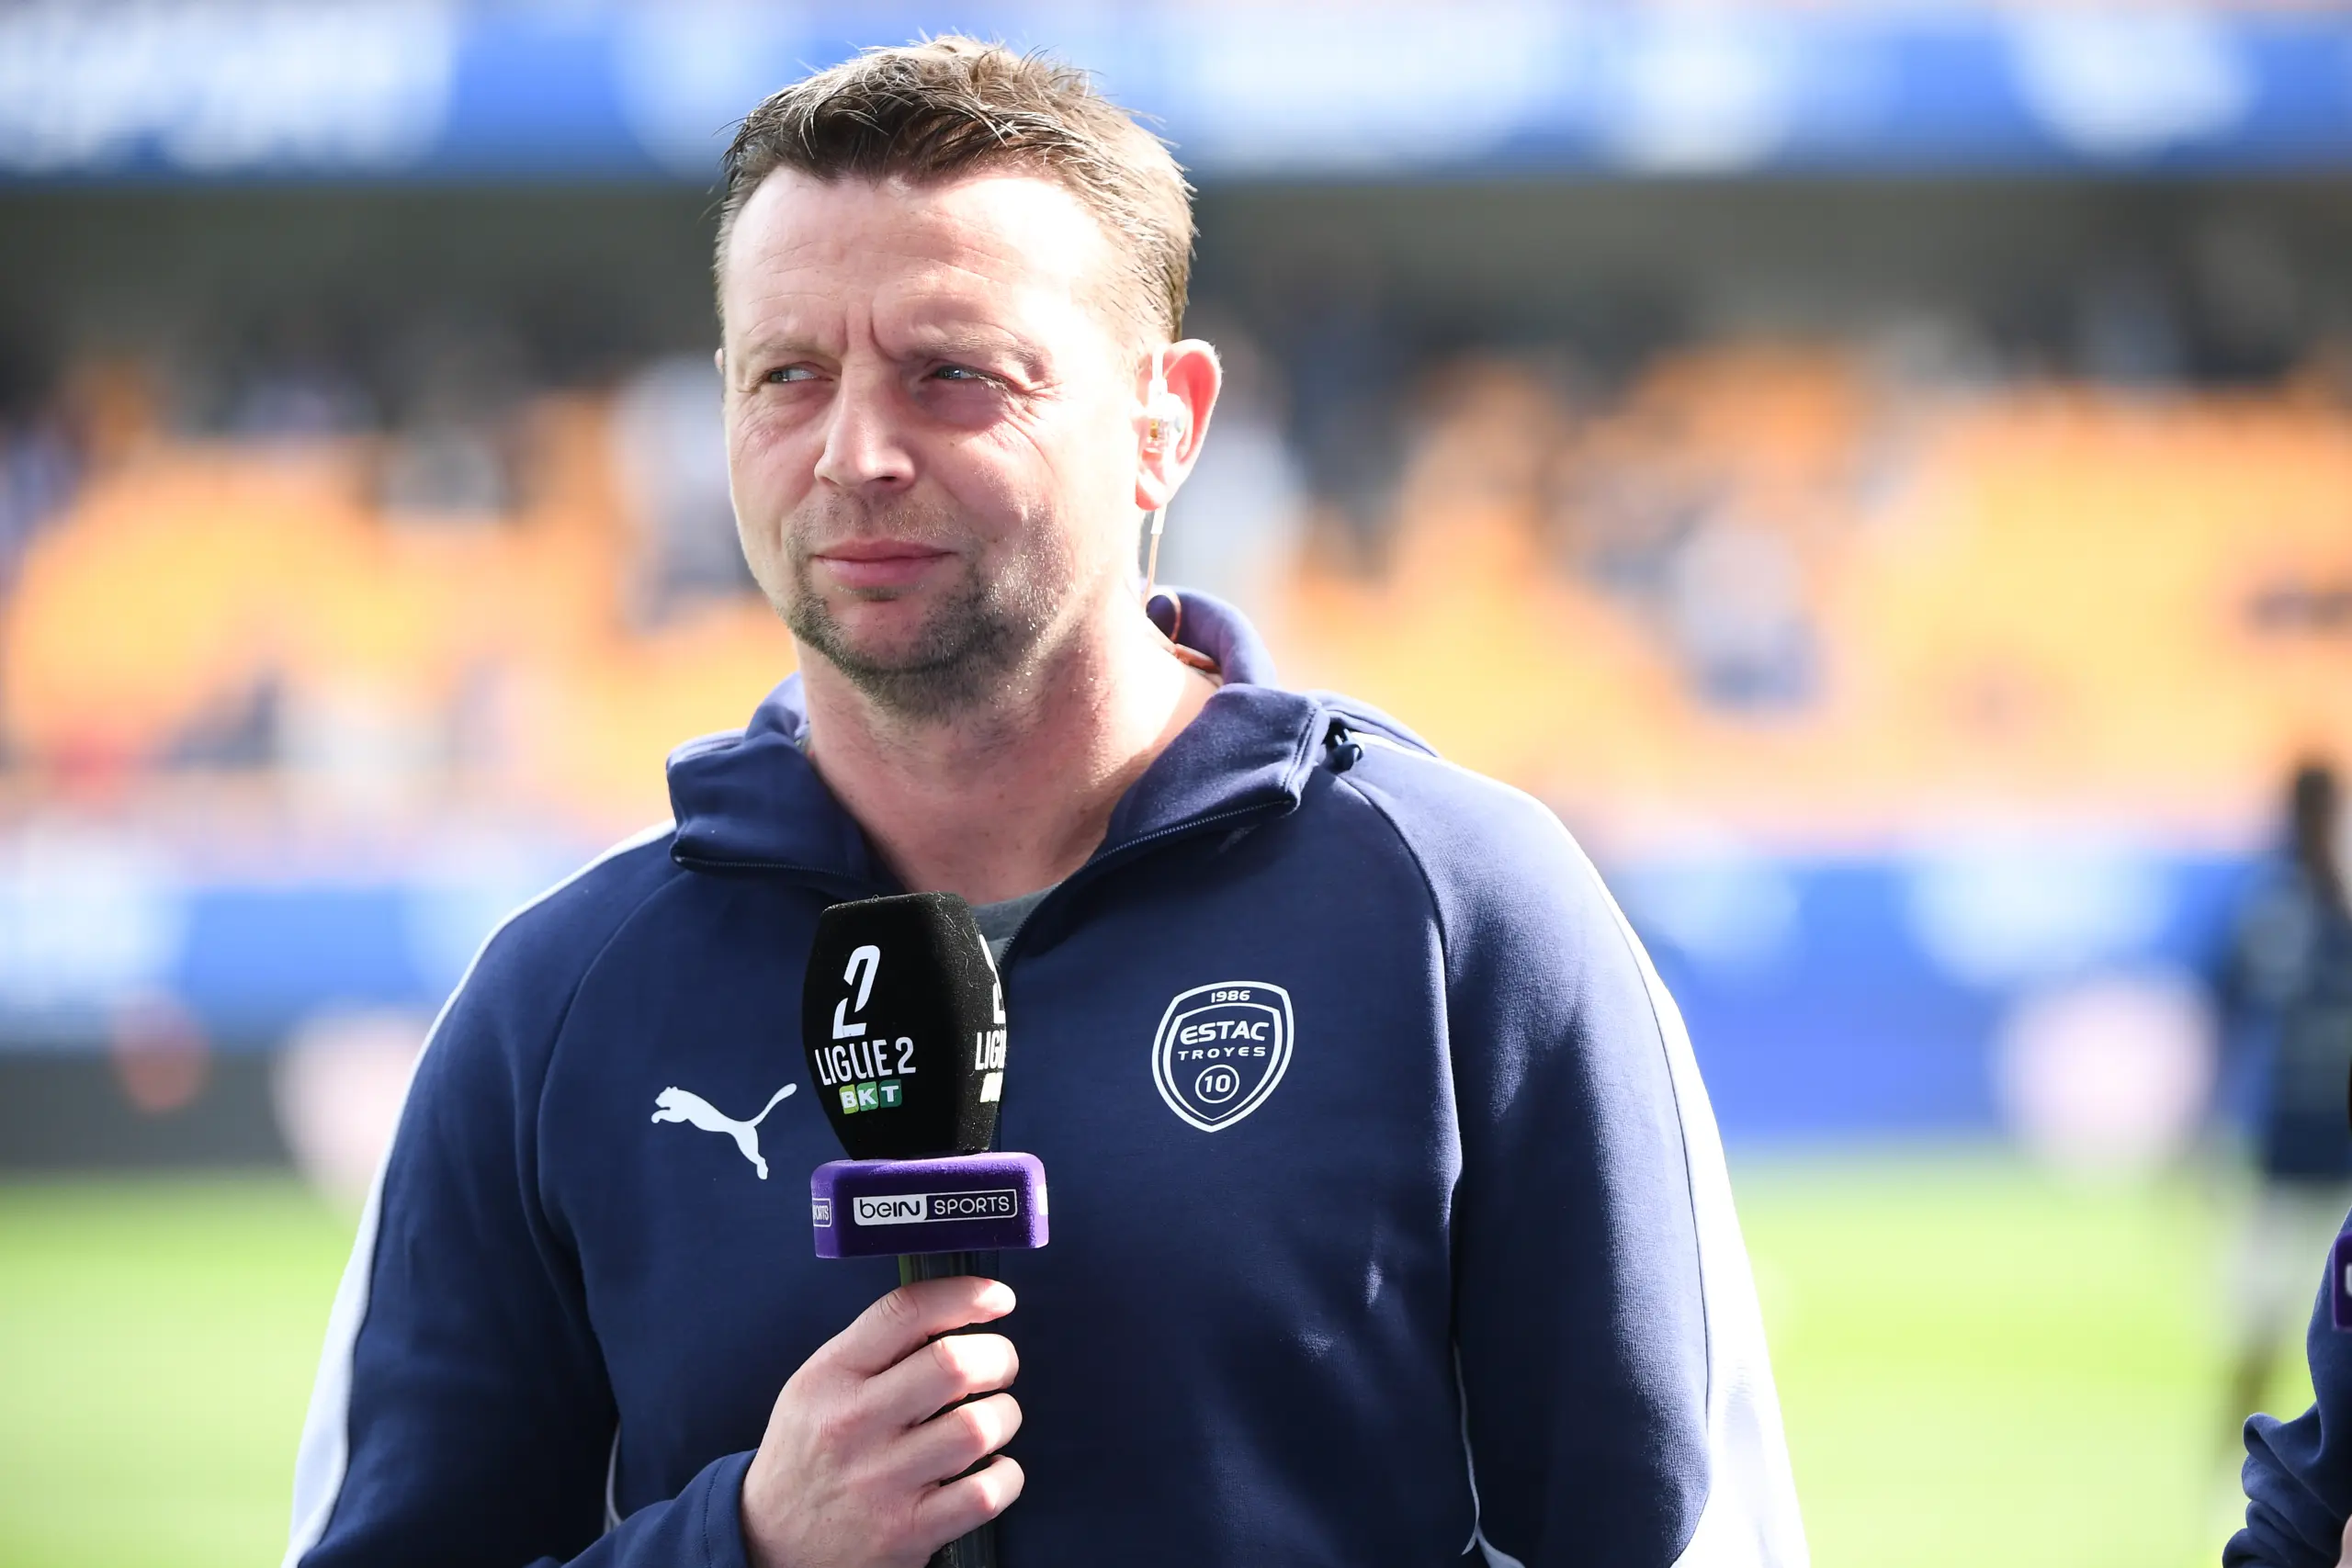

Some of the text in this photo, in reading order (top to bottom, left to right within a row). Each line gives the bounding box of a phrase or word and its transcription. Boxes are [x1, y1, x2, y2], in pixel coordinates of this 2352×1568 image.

[832, 944, 880, 1039] 2
[1211, 990, 1250, 1003] 1986
[1180, 1021, 1269, 1045] ESTAC
[895, 1036, 916, 1074] 2
[1178, 1046, 1266, 1061] TROYES
[1204, 1074, 1230, 1092] 10
[841, 1085, 899, 1109] BKT
[934, 1196, 1010, 1215] SPORTS
